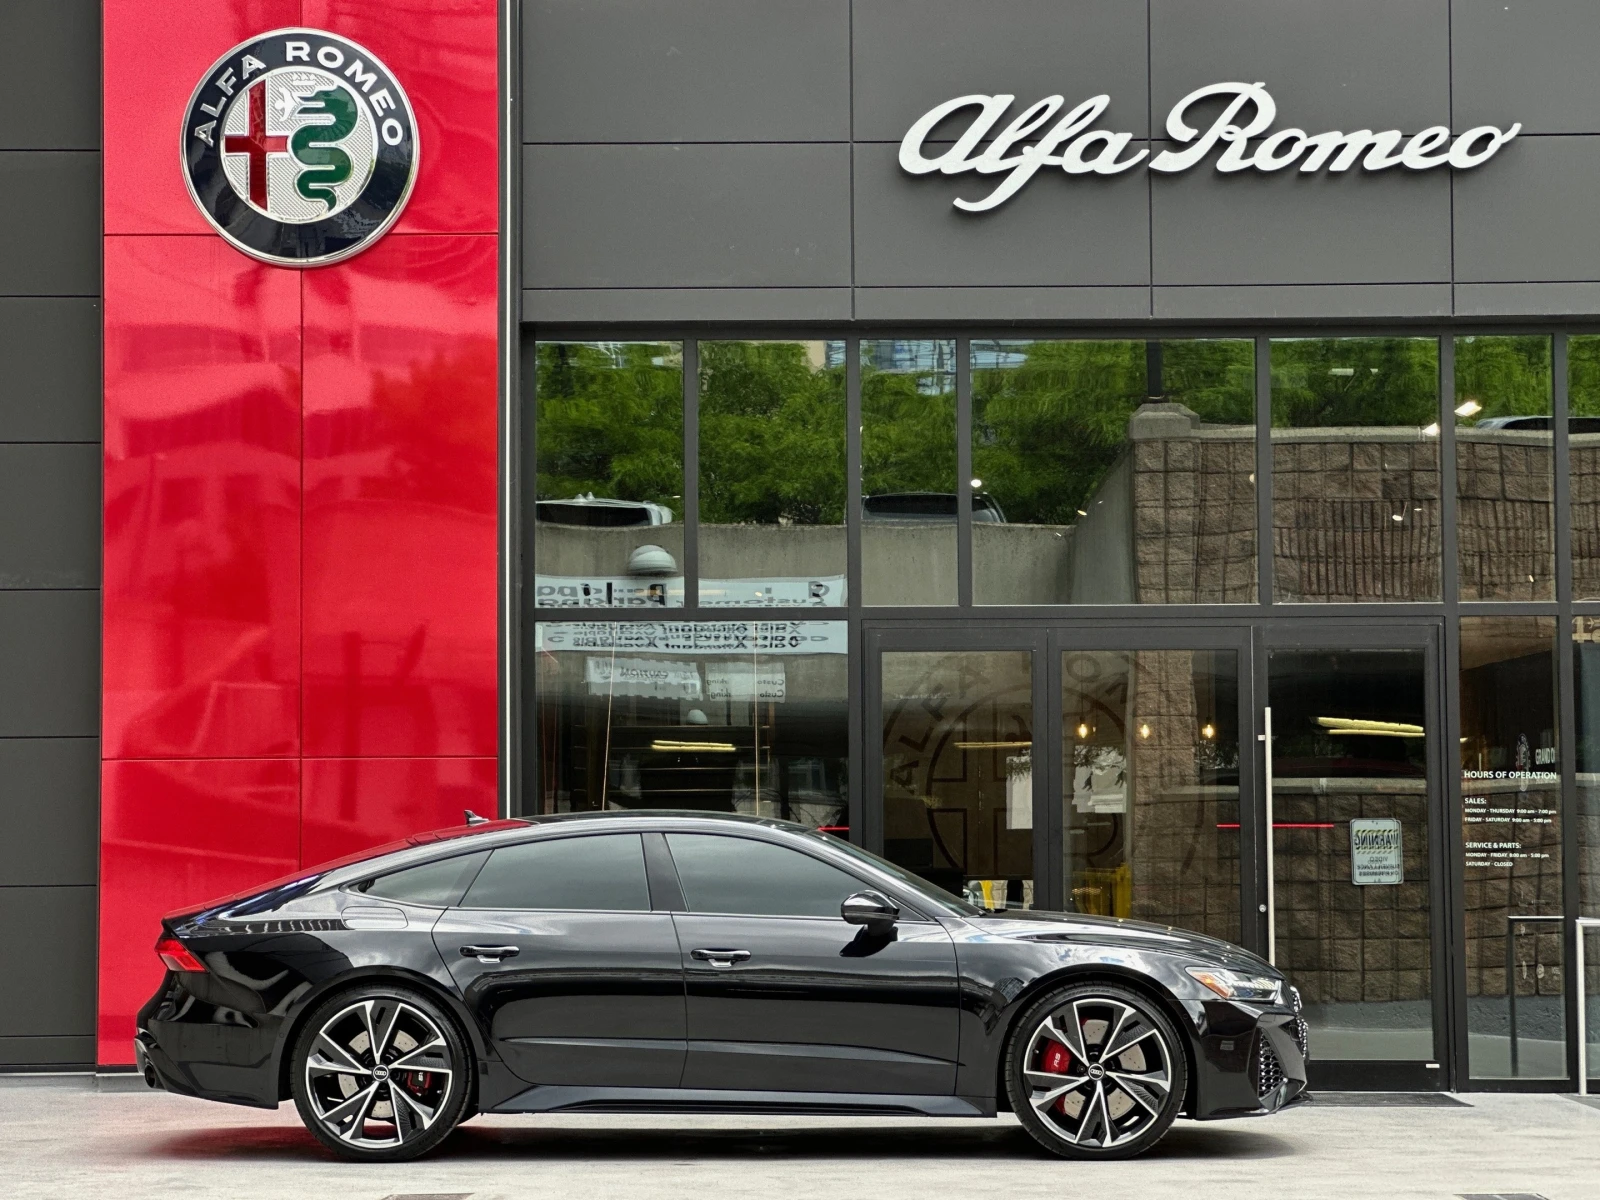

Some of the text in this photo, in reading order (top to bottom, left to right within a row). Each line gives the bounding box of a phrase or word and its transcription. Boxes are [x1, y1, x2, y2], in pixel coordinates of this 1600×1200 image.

[194, 41, 403, 147] ALFA ROMEO
[899, 81, 1522, 212] Alfa Romeo
[1508, 771, 1557, 779] OPERATION
